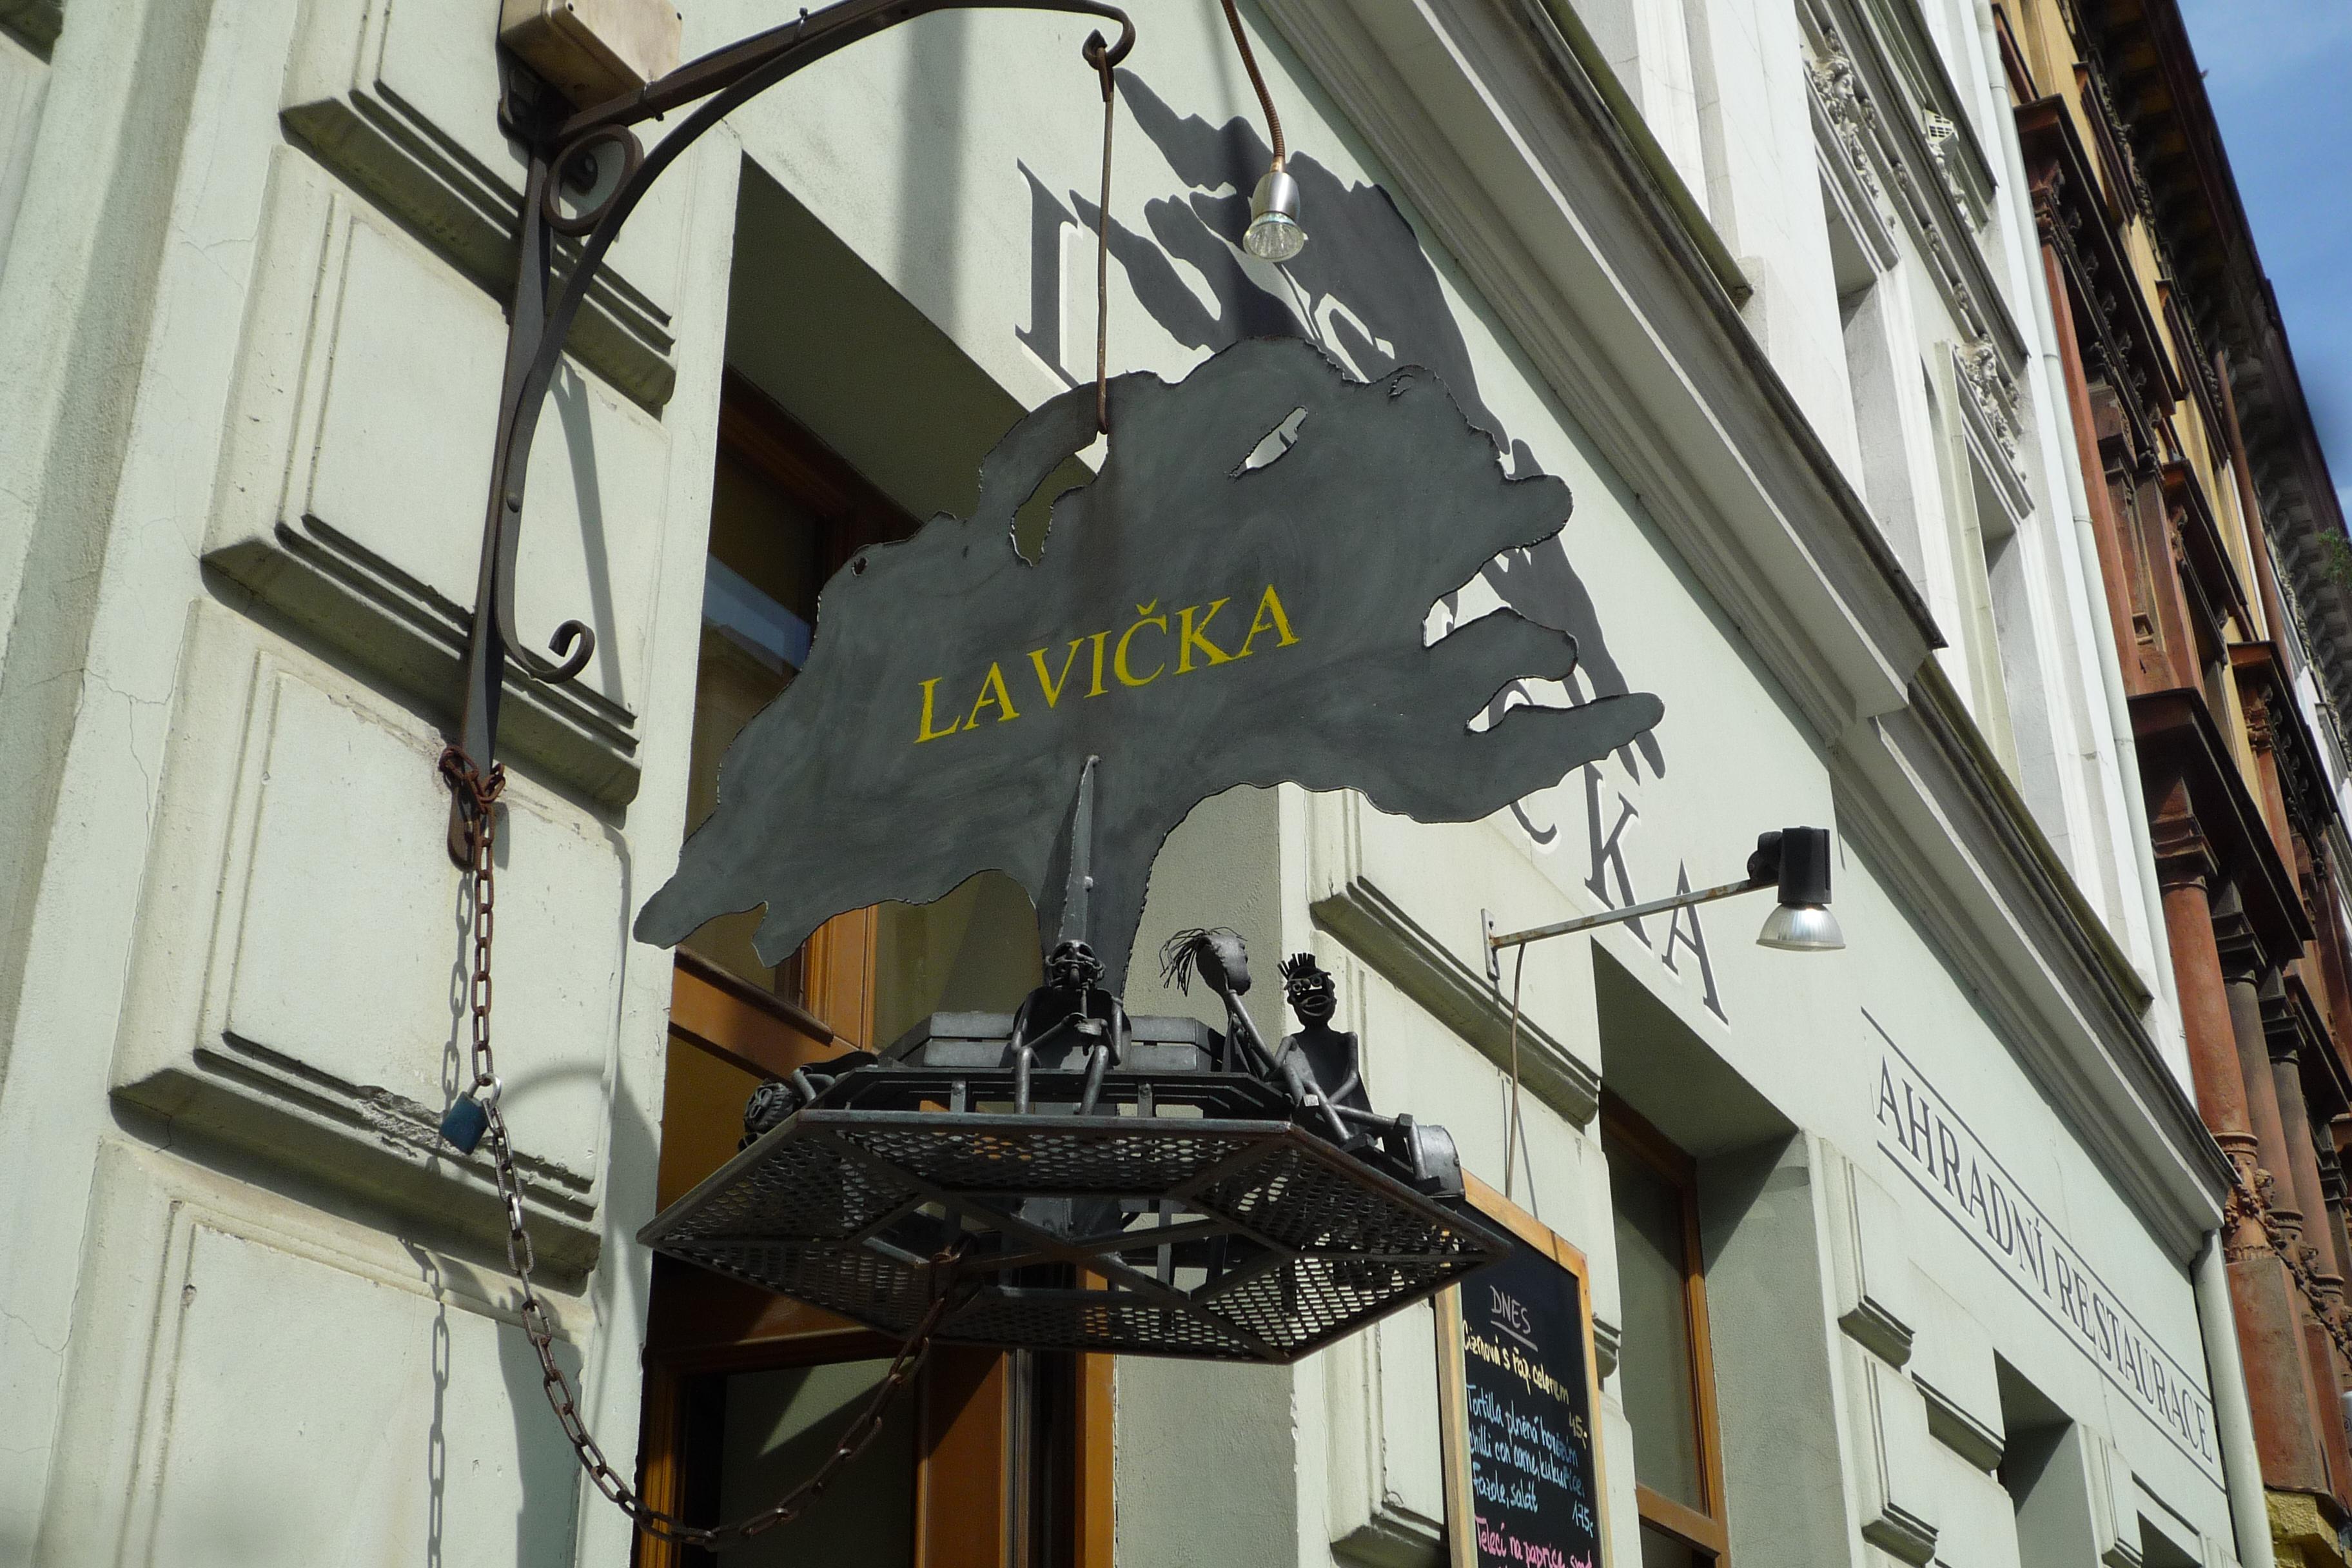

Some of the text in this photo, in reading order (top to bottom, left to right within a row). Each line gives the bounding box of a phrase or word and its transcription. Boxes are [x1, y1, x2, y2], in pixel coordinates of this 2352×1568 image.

[914, 583, 1301, 744] LAVIČKA
[1876, 1054, 2213, 1465] AHRADNÍ RESTAURACE
[1490, 1285, 1531, 1335] DNES
[1502, 1348, 1511, 1371] s
[1467, 1384, 1504, 1428] Tortilla
[1494, 1441, 1511, 1464] con
[1475, 1514, 1507, 1557] Telecí
[1509, 1535, 1524, 1560] na
